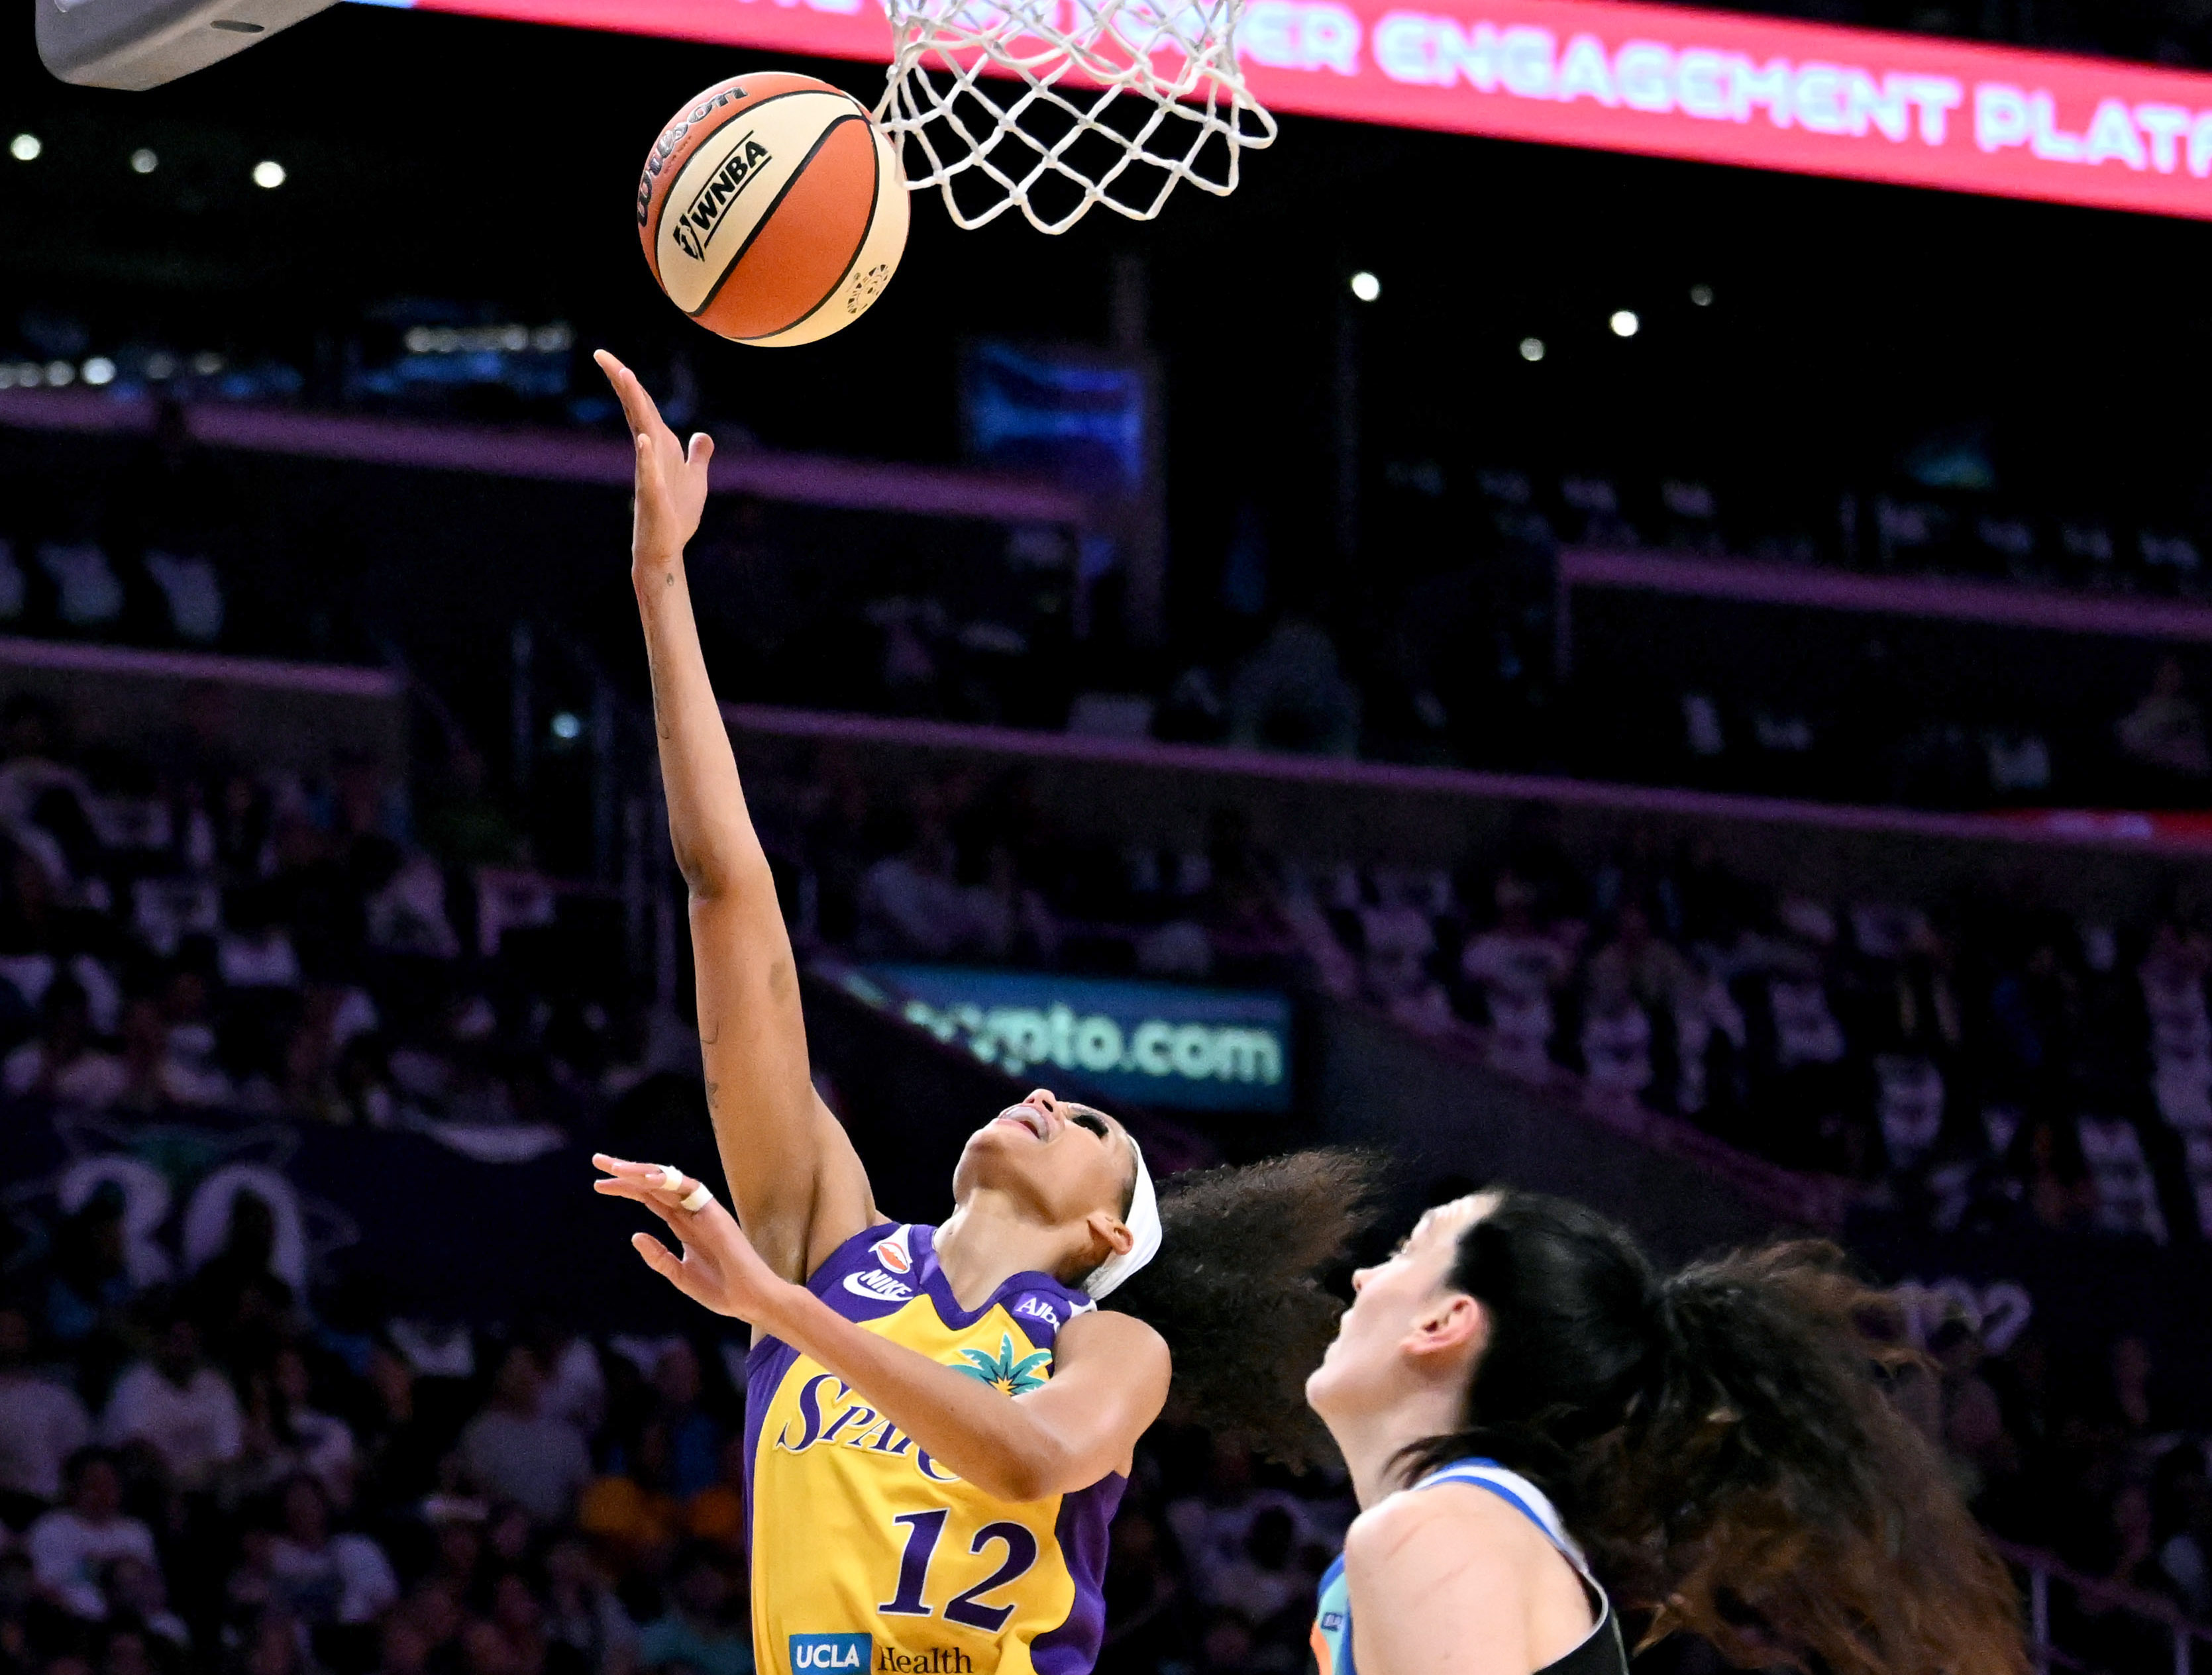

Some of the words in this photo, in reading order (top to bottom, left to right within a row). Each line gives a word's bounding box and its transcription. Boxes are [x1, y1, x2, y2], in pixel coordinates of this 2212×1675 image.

[1375, 15, 1961, 143] ENGAGEMENT
[691, 140, 768, 230] WNBA
[902, 999, 1284, 1085] ypto.com
[859, 1268, 913, 1298] NIKE
[878, 1507, 1038, 1633] 12
[796, 1643, 860, 1668] UCLA
[878, 1647, 974, 1674] Health
